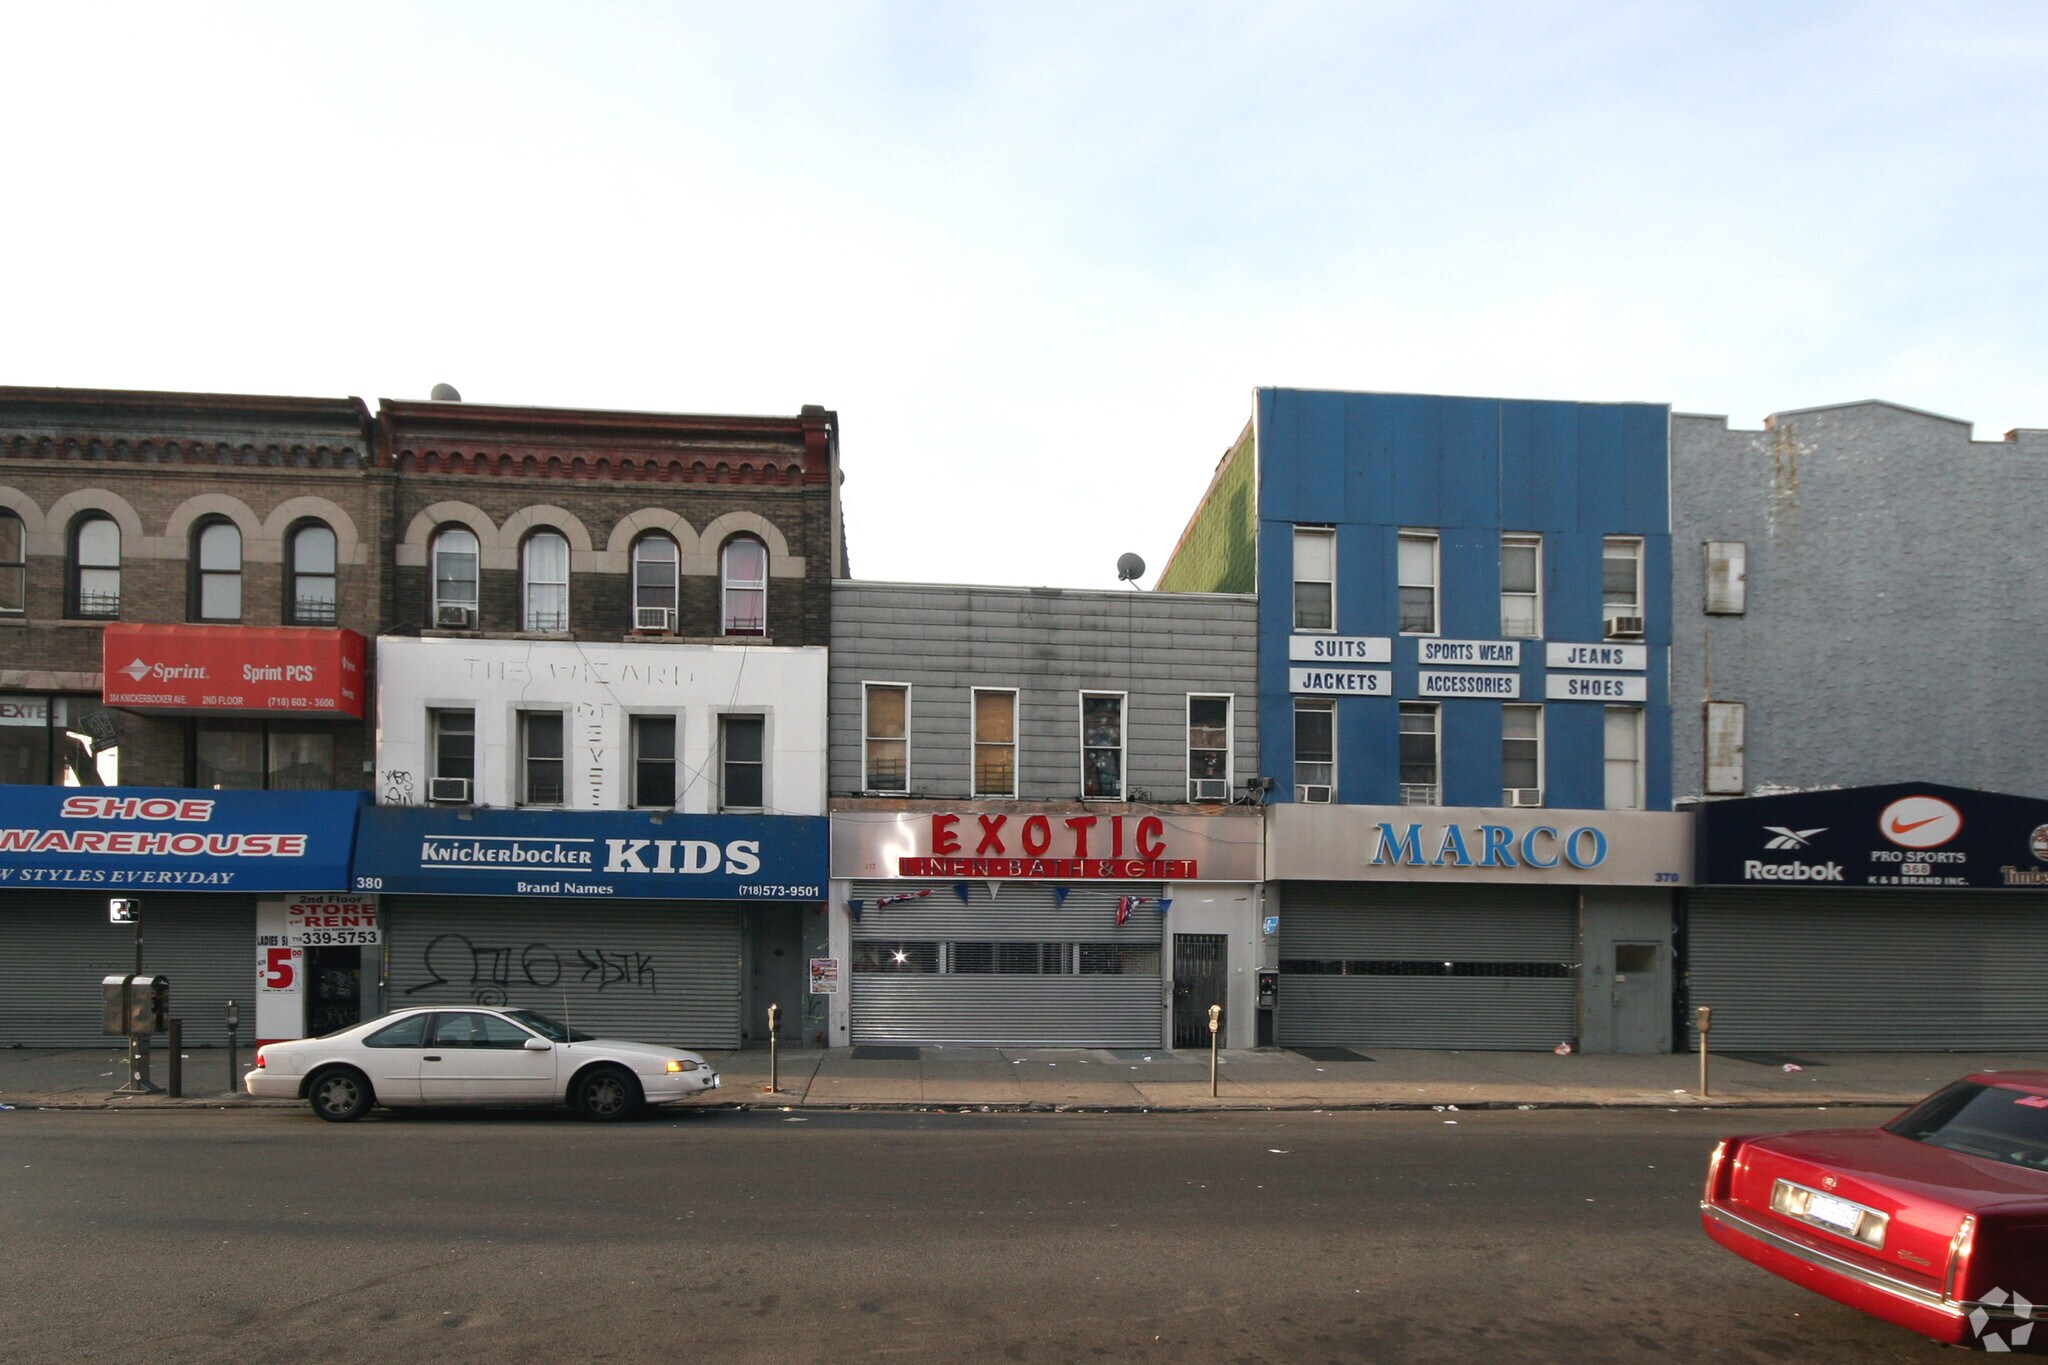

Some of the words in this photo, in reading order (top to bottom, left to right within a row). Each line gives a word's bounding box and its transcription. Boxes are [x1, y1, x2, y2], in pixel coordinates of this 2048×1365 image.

[1314, 640, 1366, 657] SUITS
[1425, 643, 1473, 660] SPORTS
[1479, 645, 1513, 662] WEAR
[1567, 648, 1624, 665] JEANS
[153, 662, 207, 682] Sprint
[243, 664, 282, 683] Sprint
[286, 665, 313, 682] PCS
[1302, 672, 1377, 691] JACKETS
[1426, 676, 1512, 694] ACCESSORIES
[1568, 679, 1624, 696] SHOES
[202, 696, 217, 705] 2ND
[218, 696, 244, 706] FLOOR
[60, 796, 215, 822] SHOE
[0, 829, 308, 857] WAREHOUSE
[931, 813, 1167, 859] EXOTIC
[1370, 822, 1610, 869] MARCO
[603, 840, 761, 875] KIDS
[1871, 851, 1902, 862] PRO
[1906, 852, 1966, 863] SPORTS
[20, 869, 106, 883] STYLES
[110, 871, 236, 885] EVERYDAY
[1008, 859, 1084, 877] BATH
[1098, 860, 1116, 877] &
[1125, 860, 1192, 878] GIFT
[1744, 860, 1844, 881] Reebok
[1904, 864, 1929, 874] 368
[356, 876, 383, 889] 380
[517, 881, 559, 894] Brand
[563, 881, 614, 894] Names
[1868, 876, 1878, 884] K
[1879, 877, 1889, 885] &
[1891, 877, 1900, 885] B
[1902, 877, 1942, 885] BRAND
[1944, 878, 1970, 886] INC.
[300, 895, 323, 904] 2nd
[328, 895, 363, 904] Floor
[289, 904, 376, 915] STORE
[304, 916, 376, 927] RENT
[257, 935, 278, 946] LADIES
[302, 931, 377, 944] 339-5753
[267, 948, 294, 989] 5
